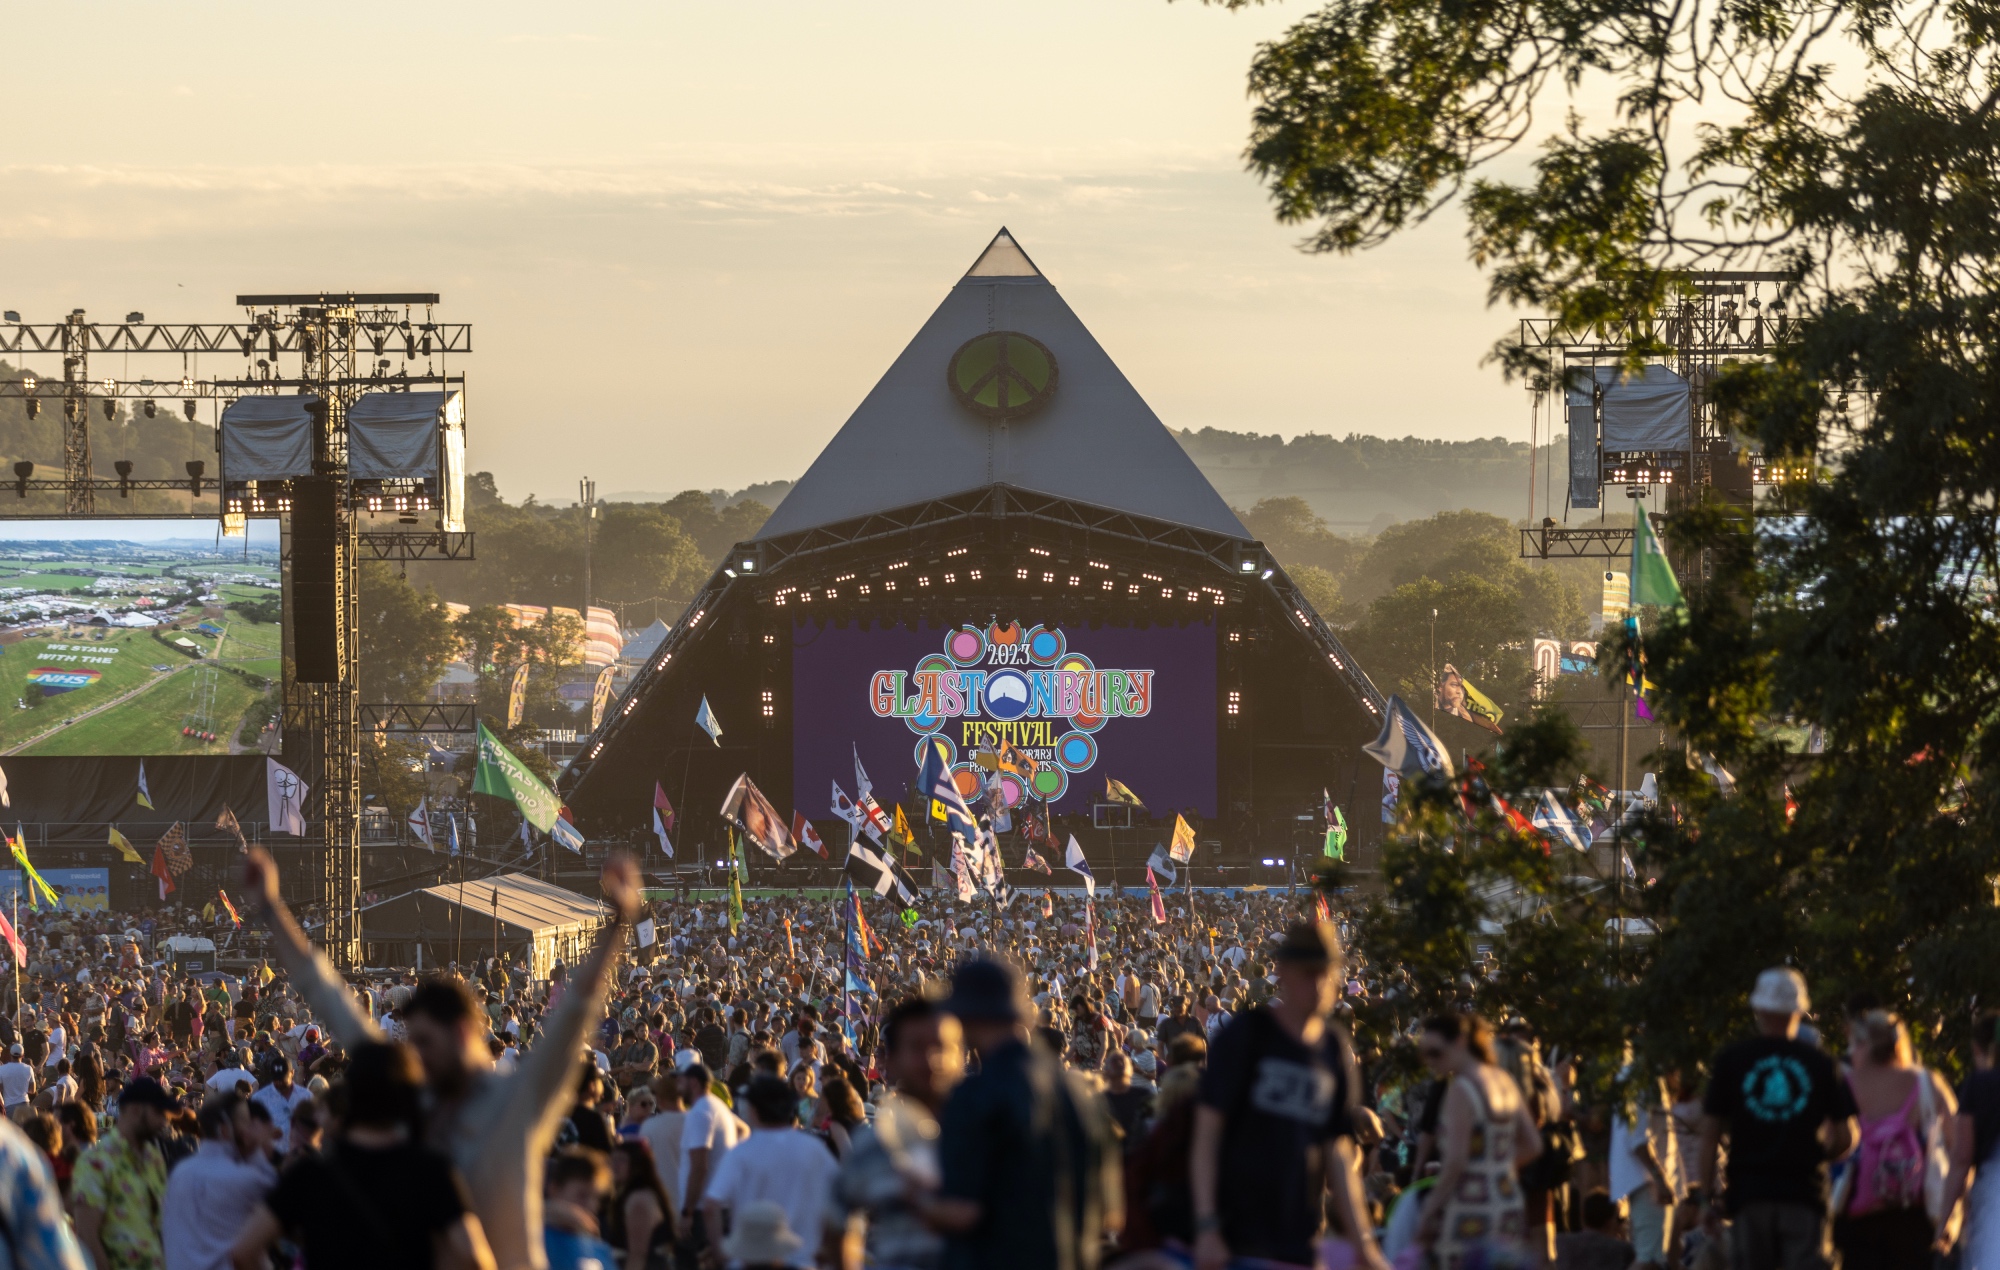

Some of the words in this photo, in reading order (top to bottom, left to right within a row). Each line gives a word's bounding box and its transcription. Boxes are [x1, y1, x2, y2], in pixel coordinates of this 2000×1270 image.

[46, 643, 69, 651] WE
[70, 645, 119, 654] STAND
[987, 643, 1031, 665] 2023
[36, 652, 77, 662] WITH
[81, 655, 113, 664] THE
[35, 673, 89, 684] NHS
[869, 668, 1155, 720] GLASTONBURY
[961, 721, 1059, 747] FESTIVAL
